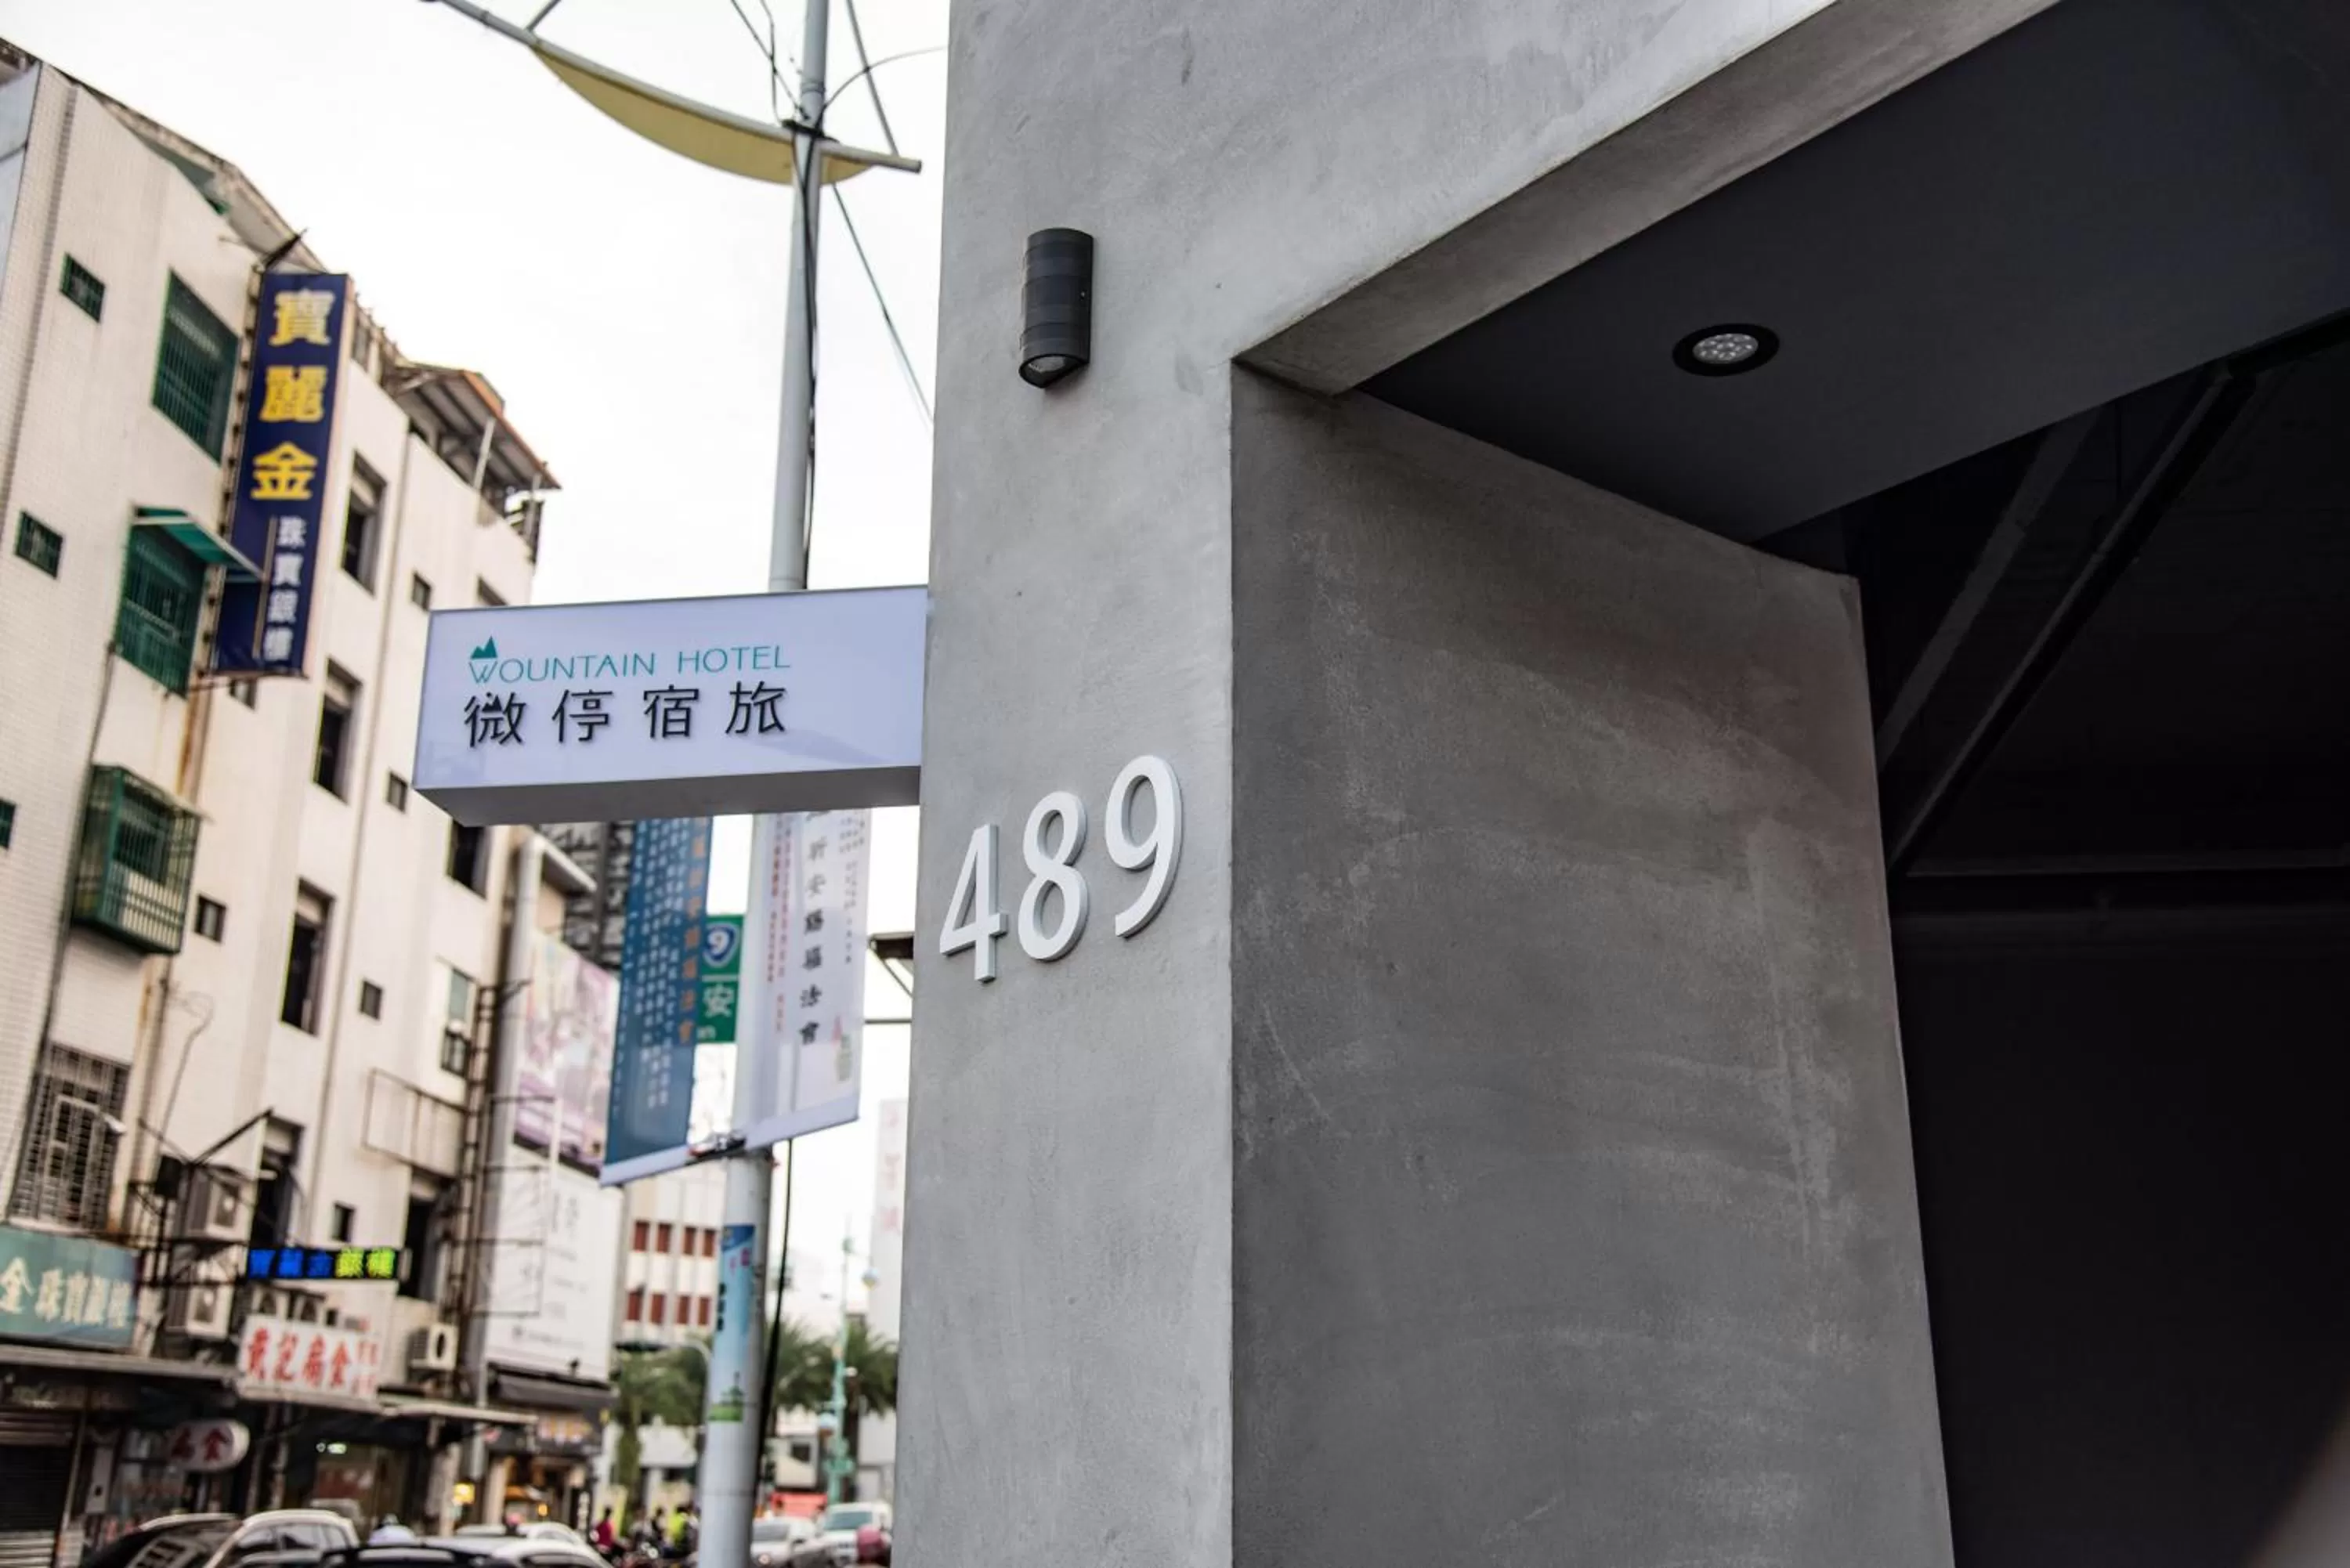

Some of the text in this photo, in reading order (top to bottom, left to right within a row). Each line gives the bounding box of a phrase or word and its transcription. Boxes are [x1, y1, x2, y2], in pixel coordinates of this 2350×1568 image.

[468, 645, 790, 684] WOUNTAIN HOTEL
[464, 681, 786, 747] 微停宿旅
[940, 754, 1183, 984] 489
[707, 930, 730, 955] 9
[703, 981, 736, 1017] 安
